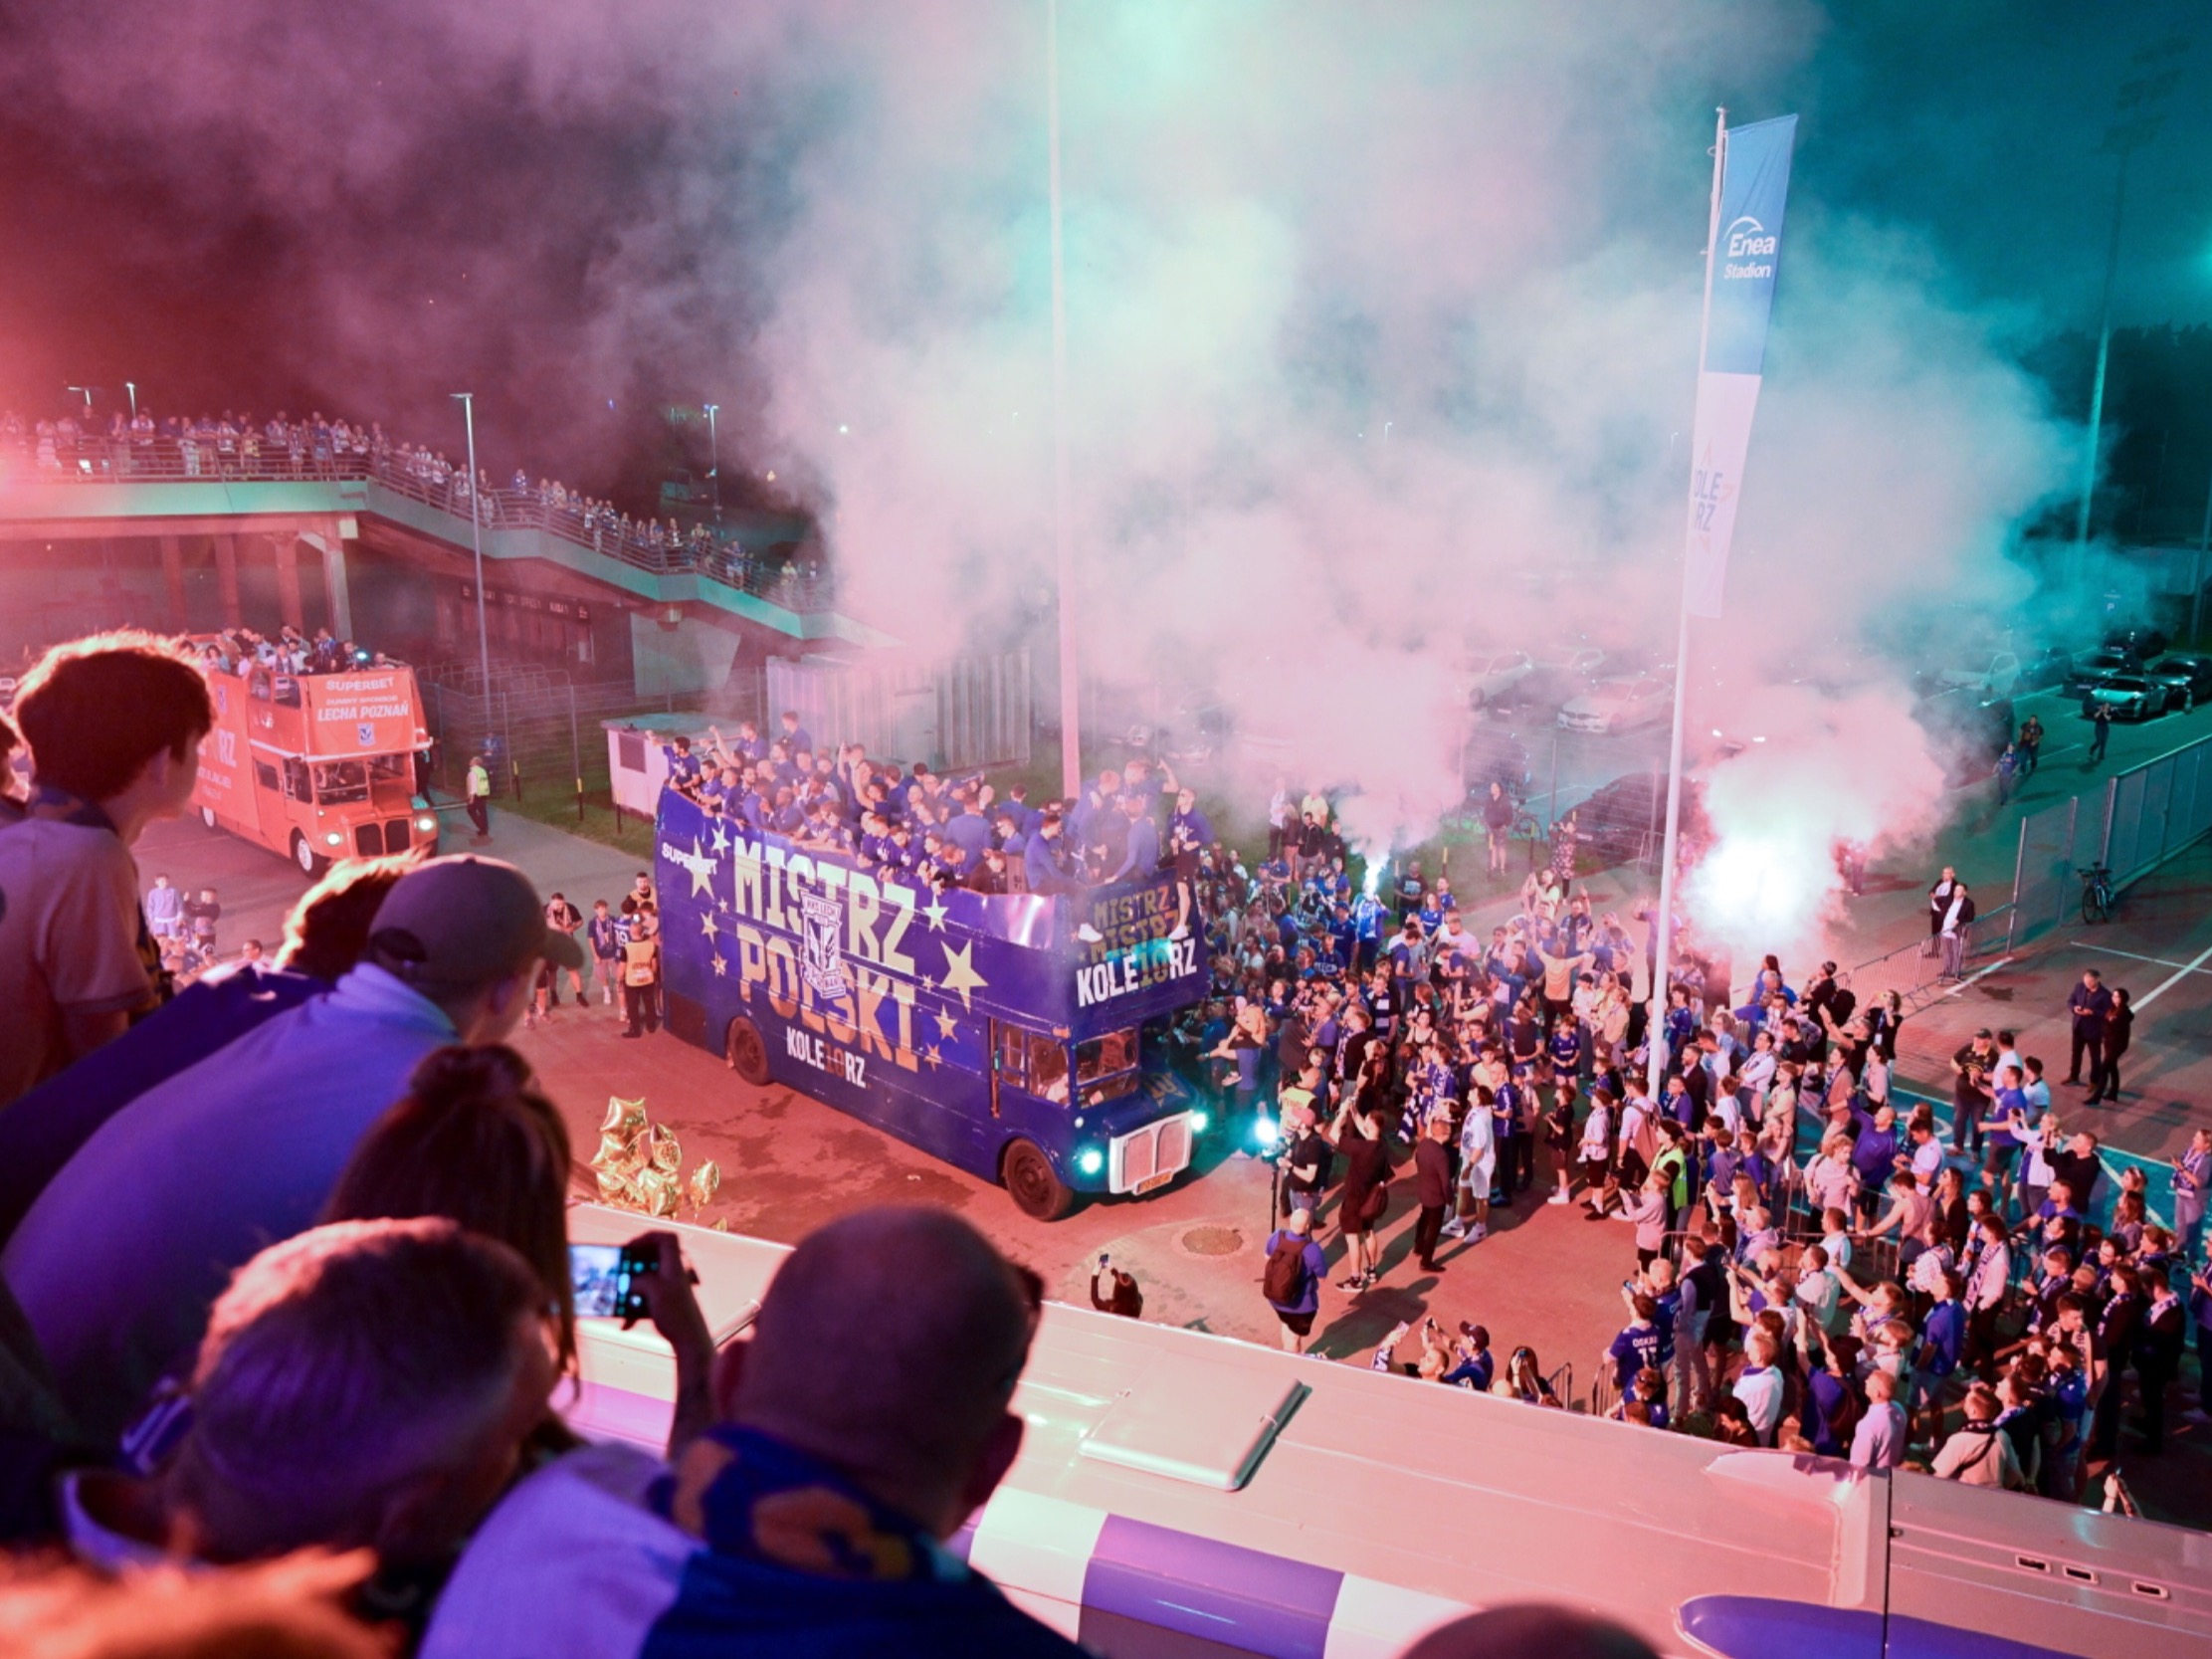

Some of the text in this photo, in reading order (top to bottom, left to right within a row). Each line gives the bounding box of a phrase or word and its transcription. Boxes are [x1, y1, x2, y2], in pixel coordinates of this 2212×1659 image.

[1727, 233, 1776, 258] Enea
[1723, 262, 1771, 280] Stadion
[325, 677, 394, 691] SUPERBET
[317, 700, 409, 723] LECHA POZNAŃ
[734, 835, 916, 978] MISTRZ
[735, 921, 918, 1073] POLSKI
